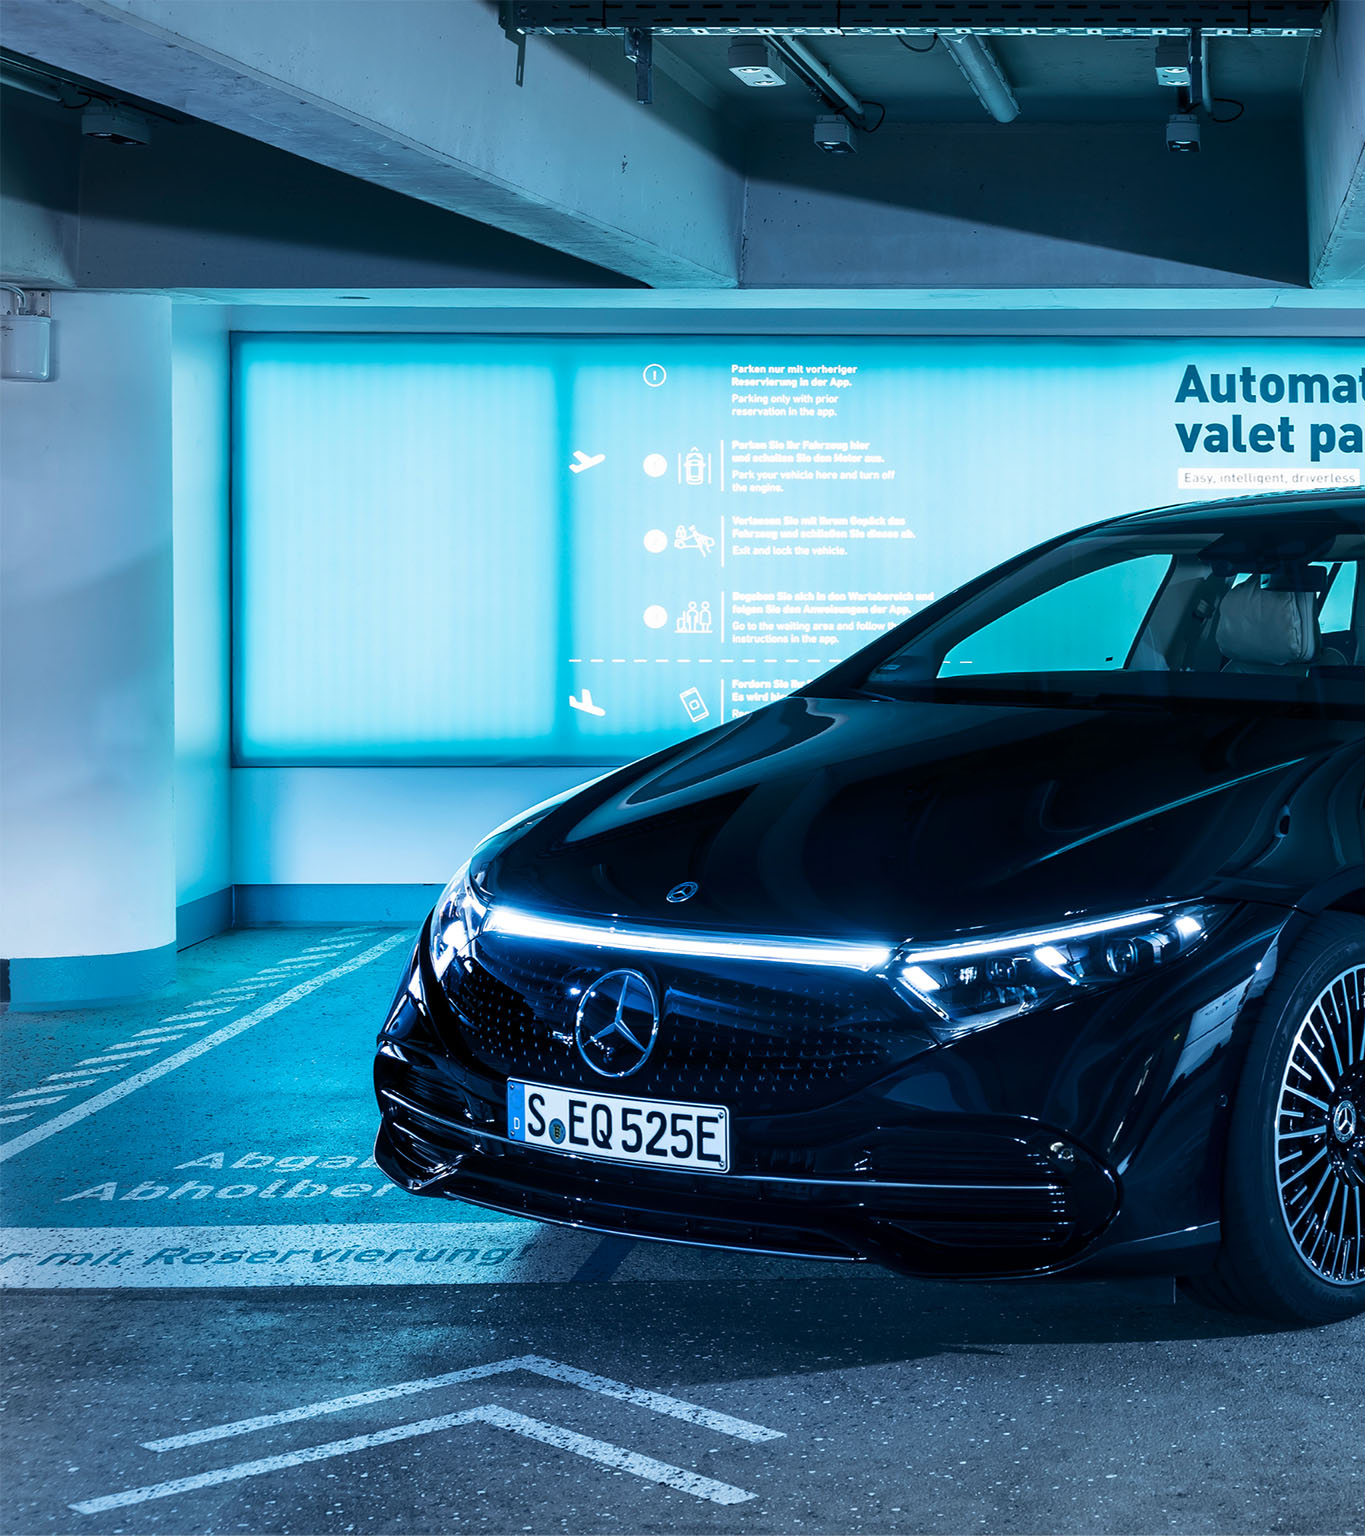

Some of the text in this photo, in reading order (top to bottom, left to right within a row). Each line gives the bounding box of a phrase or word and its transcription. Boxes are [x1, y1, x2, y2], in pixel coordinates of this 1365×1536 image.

[731, 364, 766, 373] Parken
[787, 365, 804, 373] mit
[806, 365, 857, 375] vorheriger
[732, 377, 852, 388] Reservierung in der App.
[732, 393, 839, 405] Parking only with prior
[732, 407, 837, 418] reservation in the app.
[1175, 414, 1294, 453] valet
[732, 470, 895, 480] Park your vehicle here and turn off
[1184, 472, 1356, 485] Easy, intelligent, driverless
[732, 483, 784, 494] the engine.
[732, 545, 847, 555] Exit and lock the vehicle.
[733, 620, 899, 632] Go to the waiting area and follow th
[732, 634, 839, 645] instructions in the app.
[514, 1117, 520, 1130] D
[528, 1093, 721, 1162] S EQ 525E
[174, 1151, 377, 1173] Abga
[61, 1179, 396, 1201] Abholber
[37, 1248, 134, 1266] mit
[142, 1240, 539, 1266] Reservierung!
